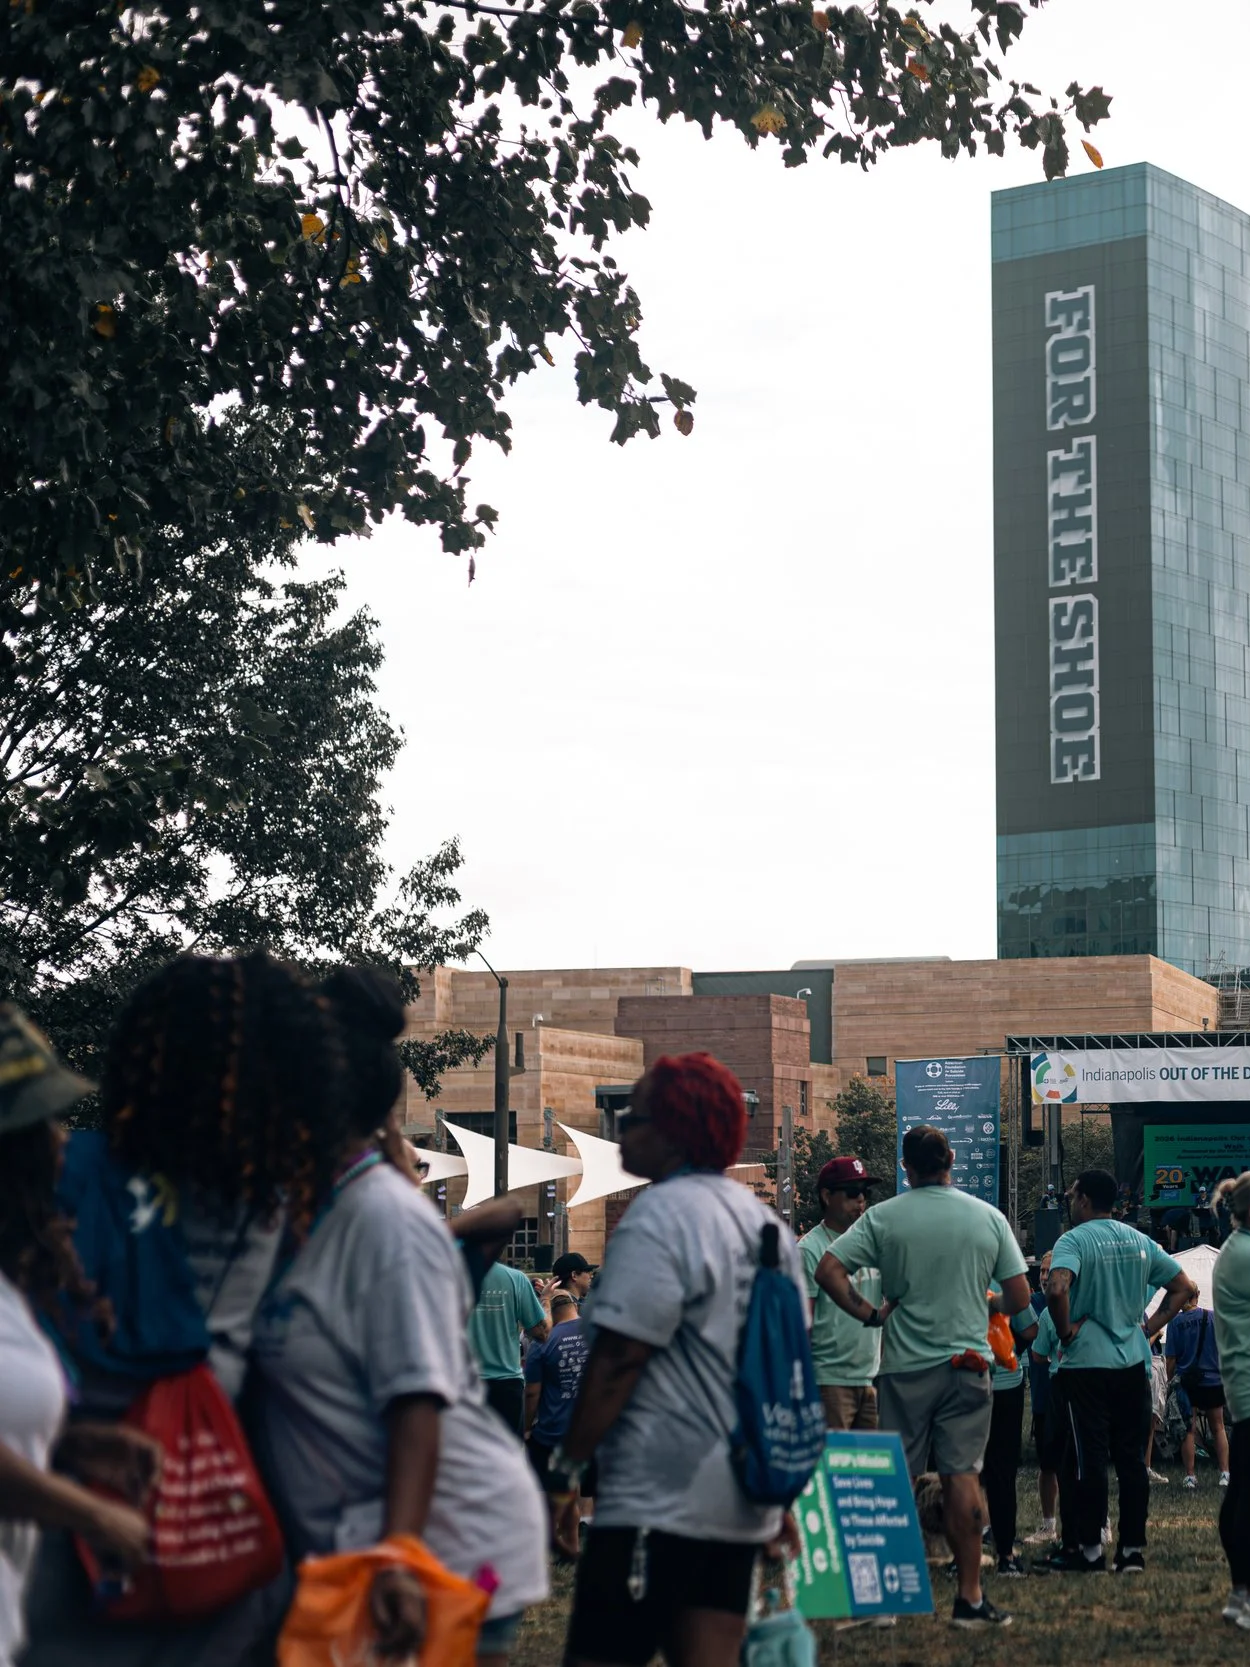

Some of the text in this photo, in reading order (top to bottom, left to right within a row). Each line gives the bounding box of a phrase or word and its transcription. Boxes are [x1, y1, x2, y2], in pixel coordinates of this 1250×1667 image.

[1045, 285, 1100, 784] FOR THE SHOE
[1082, 1068, 1156, 1083] Indianapolis
[1159, 1067, 1188, 1080] OUT
[1191, 1067, 1211, 1080] OF
[1212, 1066, 1239, 1080] THE
[935, 1099, 960, 1113] Lilly
[1155, 1169, 1183, 1185] 20
